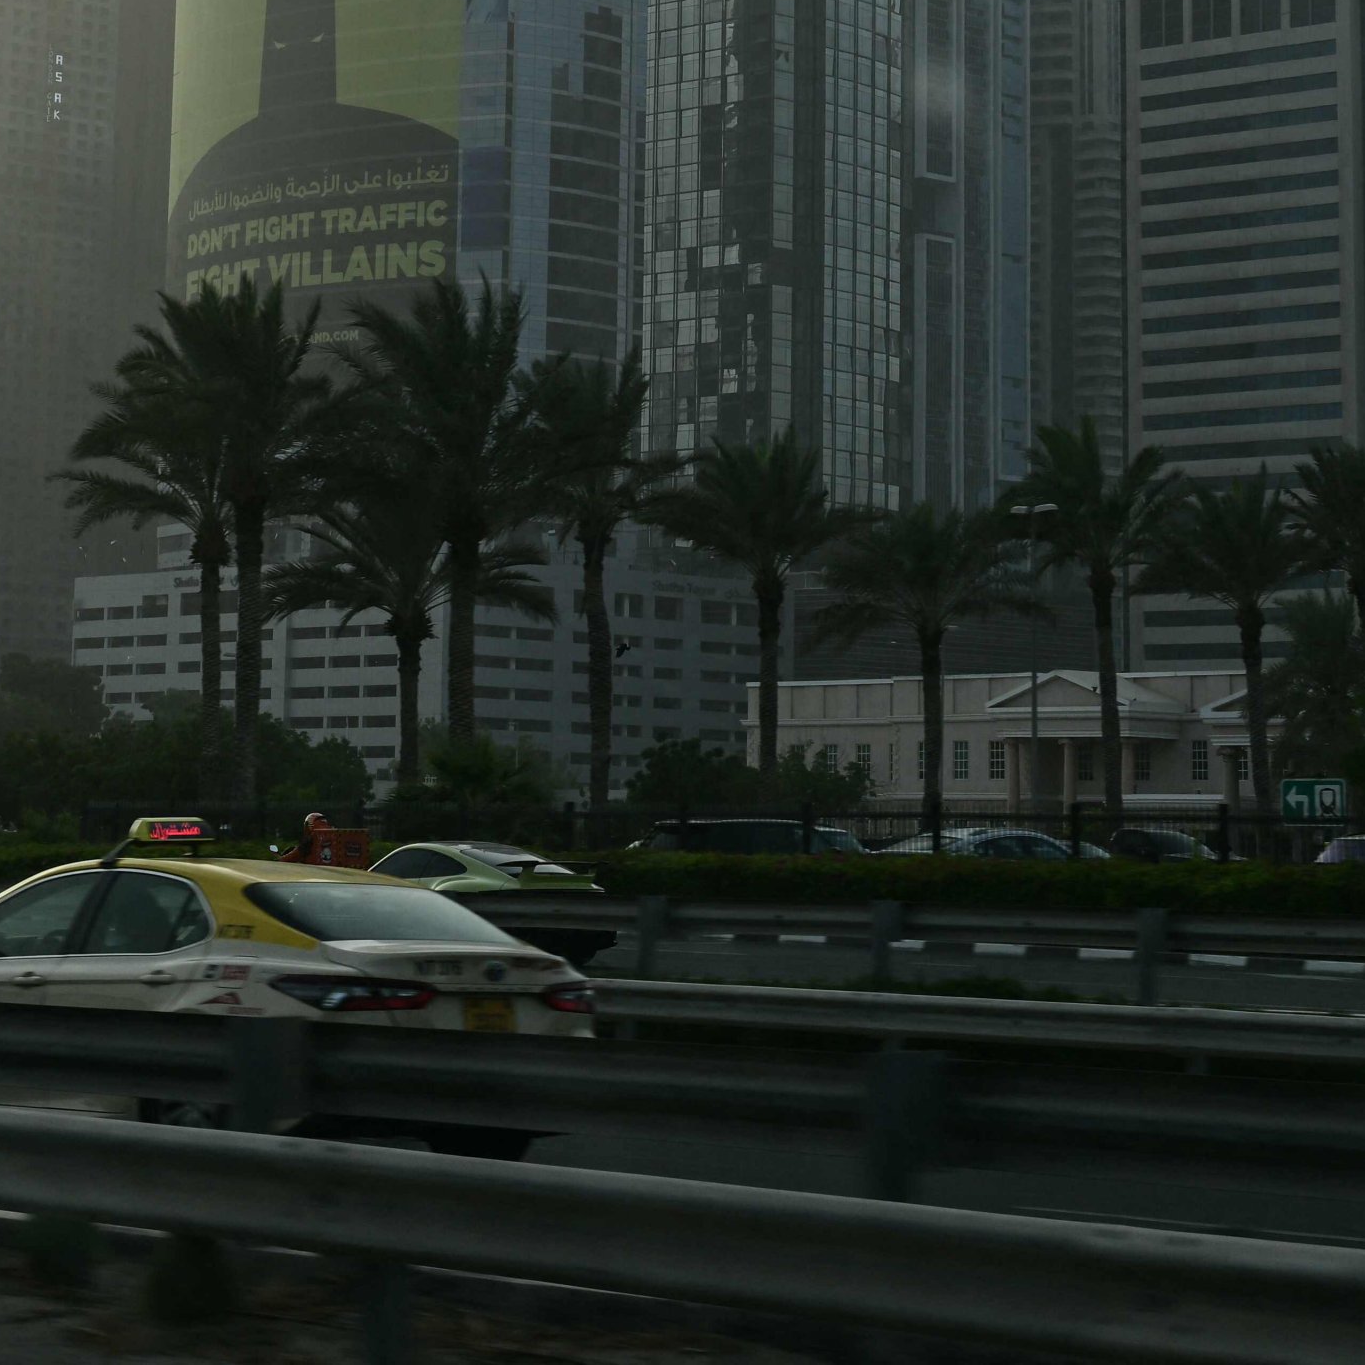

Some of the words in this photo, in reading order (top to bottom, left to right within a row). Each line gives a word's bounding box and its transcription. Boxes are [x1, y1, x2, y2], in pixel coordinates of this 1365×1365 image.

[343, 170, 382, 194] على
[186, 223, 241, 260] DON'T
[244, 210, 314, 246] FIGHT
[320, 199, 449, 236] TRAFFIC
[185, 256, 261, 302] FIGHT
[267, 238, 447, 288] VILLAINS
